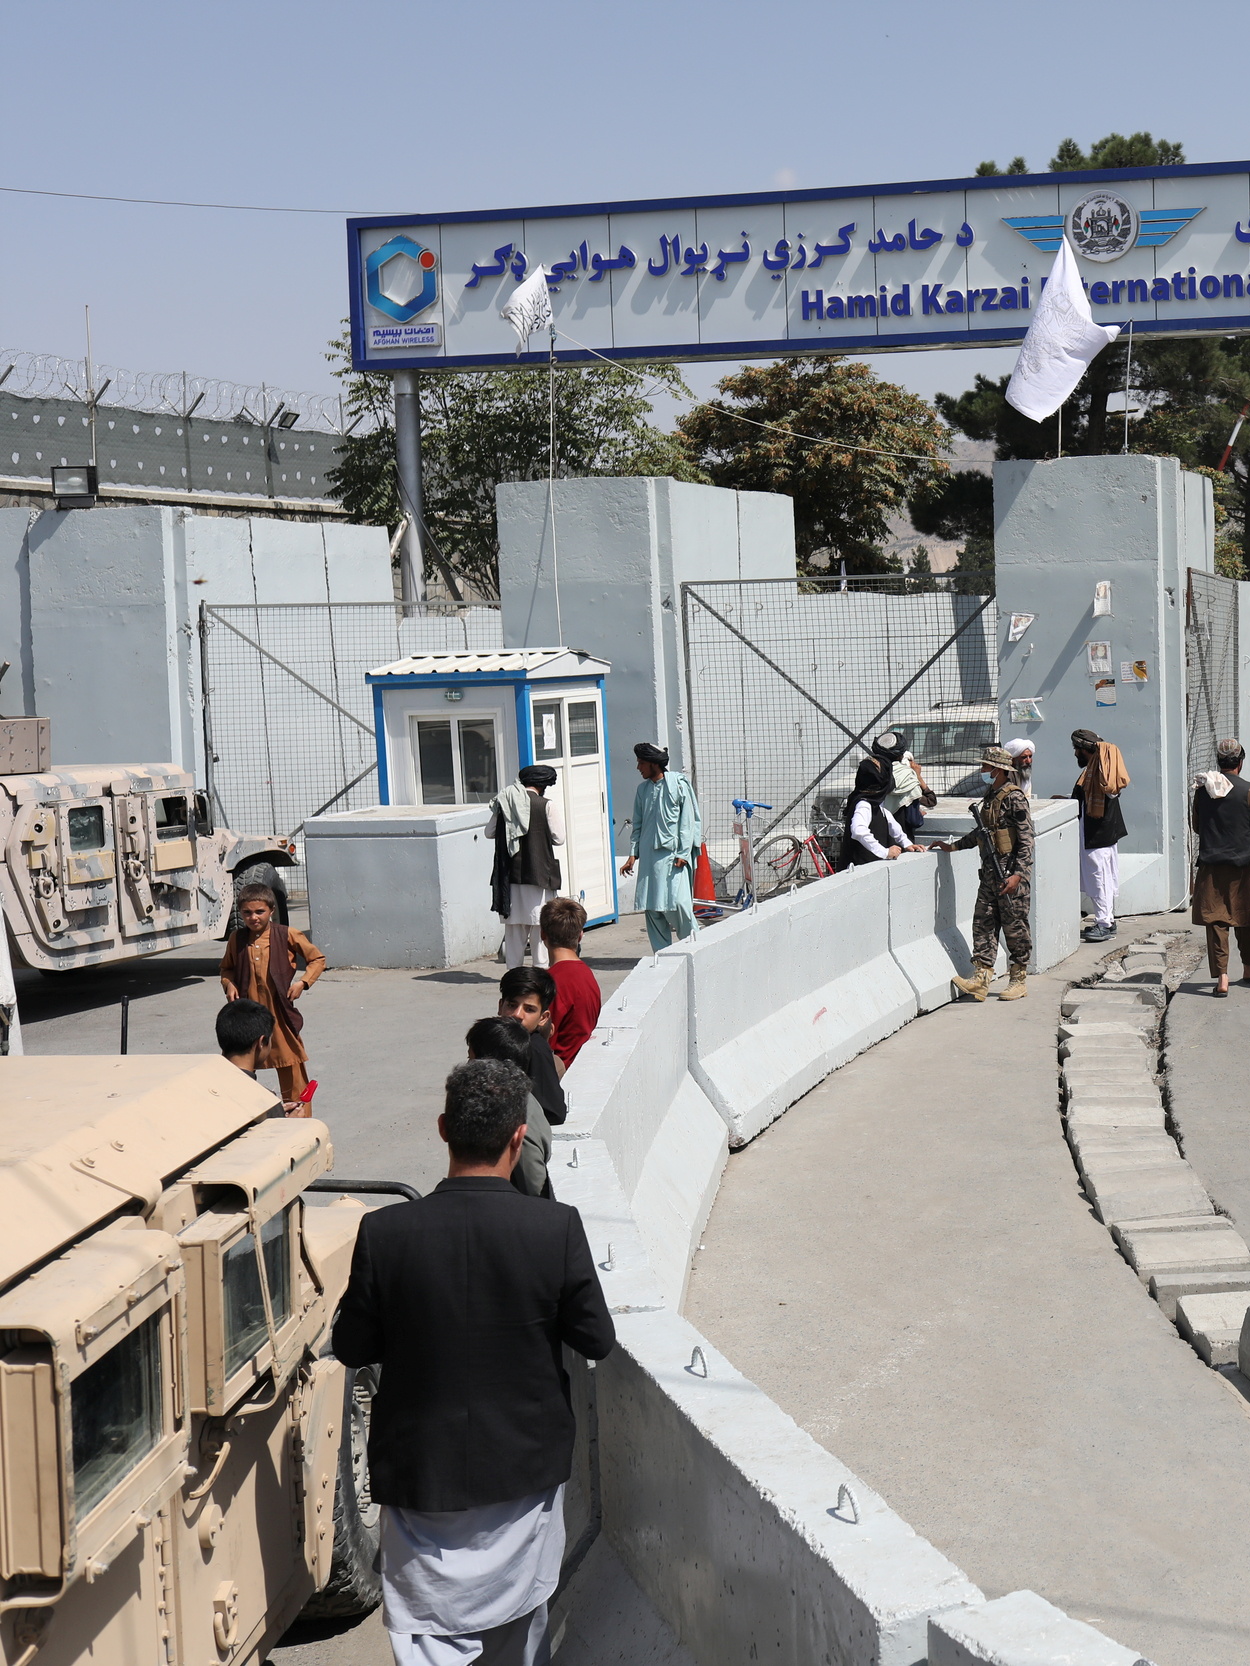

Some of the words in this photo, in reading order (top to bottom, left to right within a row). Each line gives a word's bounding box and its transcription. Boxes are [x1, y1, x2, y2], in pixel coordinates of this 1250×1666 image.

[763, 222, 856, 281] کرزي
[868, 218, 944, 255] حامد
[956, 221, 974, 248] د
[801, 284, 912, 321] Hamid
[921, 276, 1031, 316] Karzai
[373, 337, 400, 346] AFGHAN
[401, 335, 435, 344] WIRELESS
